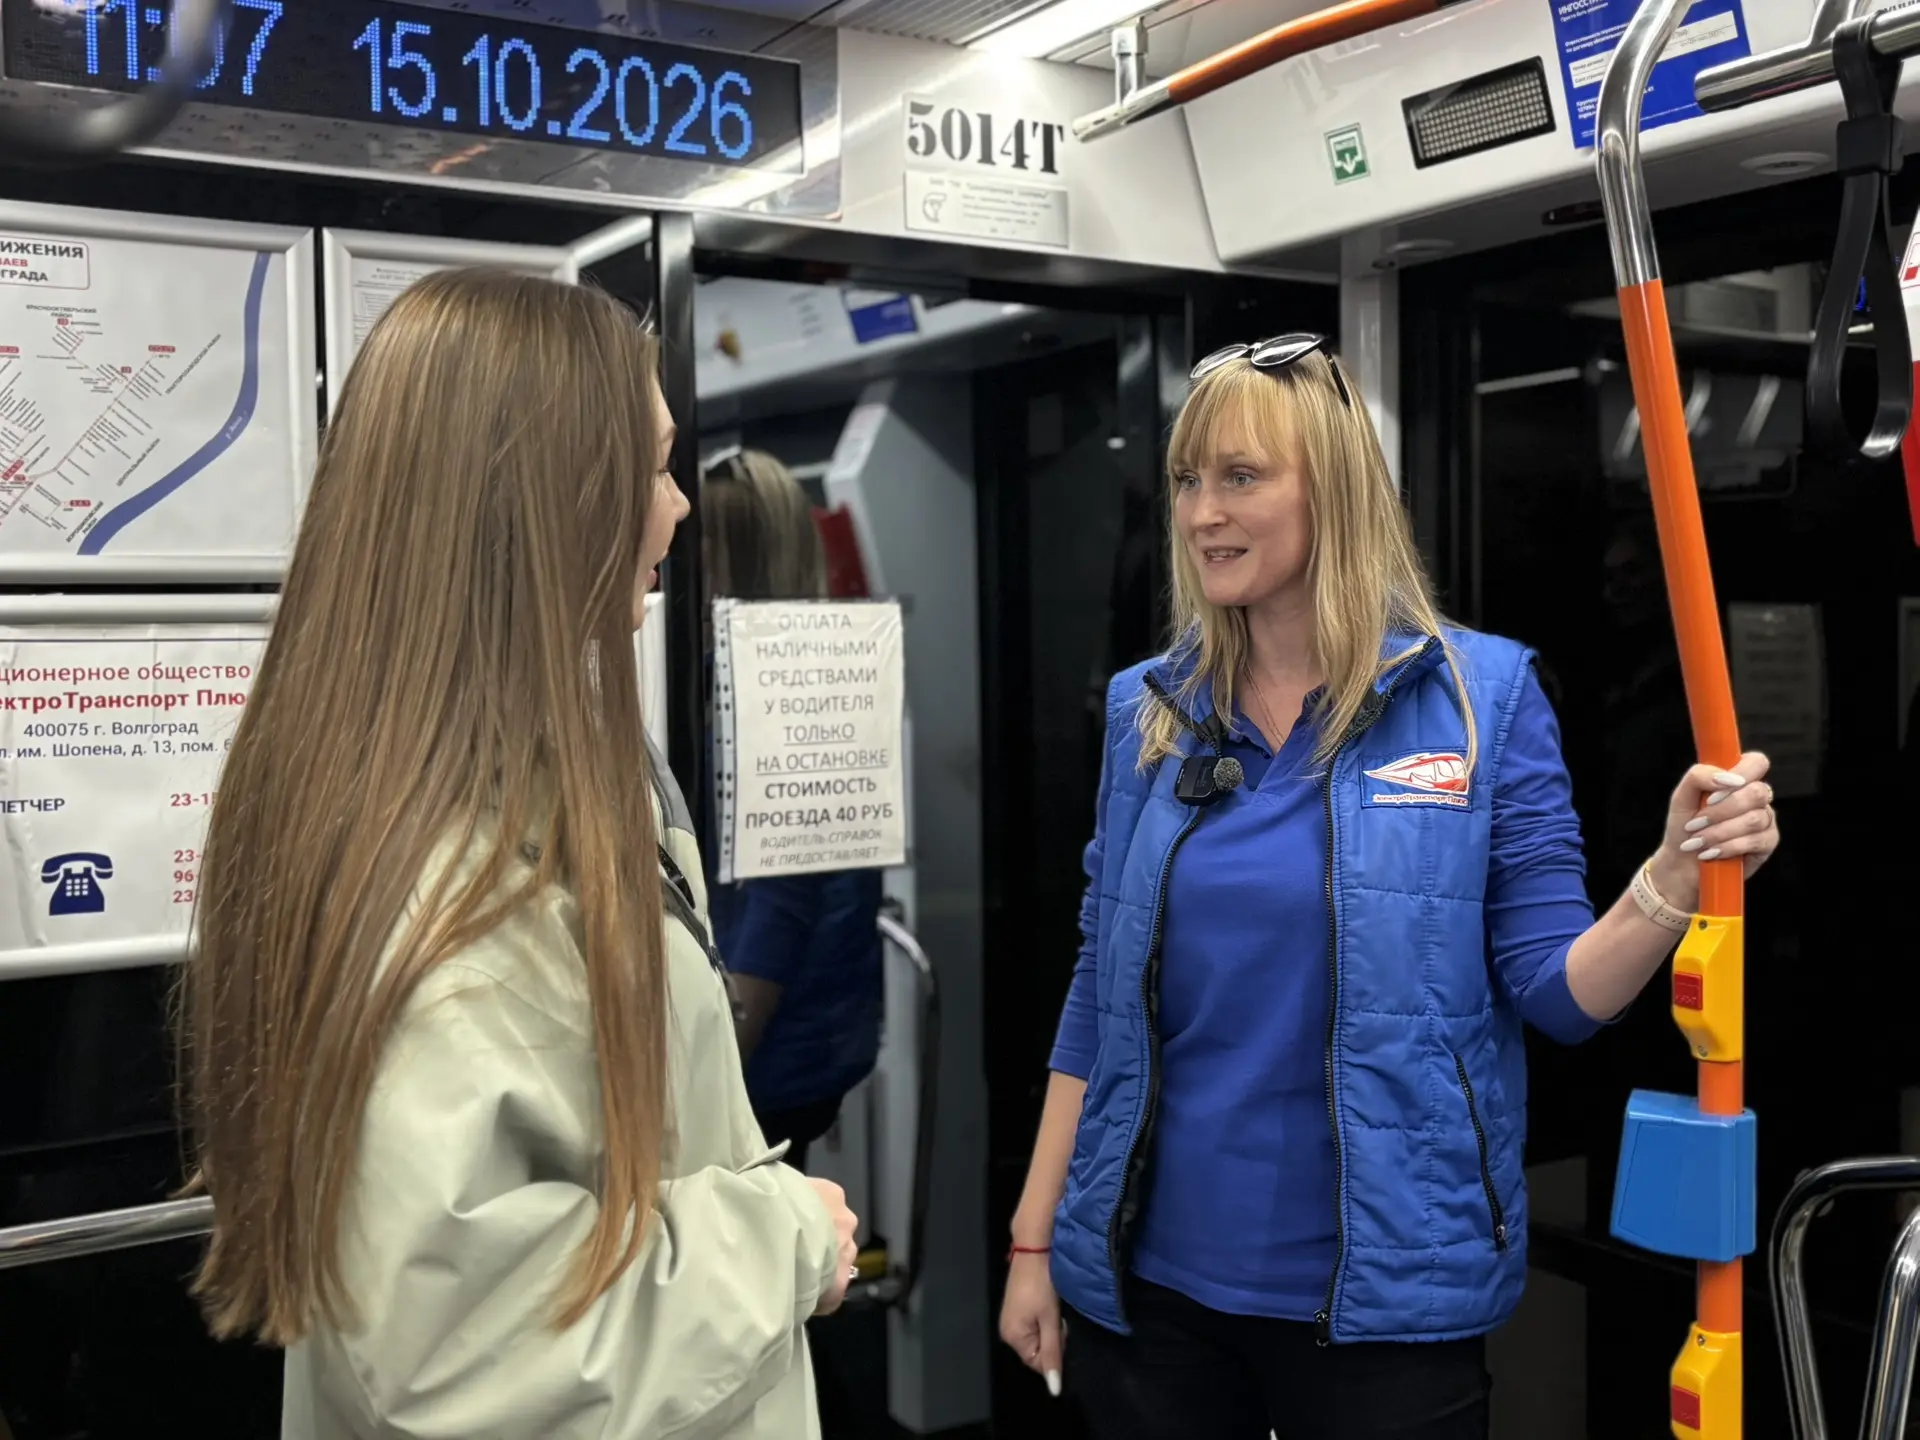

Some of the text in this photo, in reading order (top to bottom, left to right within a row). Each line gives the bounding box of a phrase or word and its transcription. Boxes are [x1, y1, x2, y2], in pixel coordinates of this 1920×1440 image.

[352, 17, 753, 160] 15.10.2026
[907, 101, 1064, 174] 5014T
[0, 241, 84, 259] ИЖЕНИЯ
[0, 257, 28, 267] АЕВ
[778, 613, 852, 630] ОПЛАТА
[755, 640, 878, 659] НАЛИЧНЫМИ
[137, 661, 251, 683] общество
[758, 668, 878, 688] СРЕДСТВАМИ
[0, 690, 189, 714] ктроТранспорт
[764, 695, 875, 715] У ВОДИТЕЛЯ
[23, 721, 199, 737] 400075 г. Волгоград
[784, 722, 856, 743] ТОЛЬКО
[17, 747, 46, 758] им.
[52, 743, 126, 757] Шопена,
[131, 743, 147, 756] д.
[153, 740, 176, 755] 13,
[181, 741, 218, 753] пом.
[756, 749, 889, 773] НА ОСТАНОВКЕ
[764, 776, 877, 799] СТОИМОСТЬ
[745, 803, 893, 829] ПРОЕЗДА 40 РУБ
[828, 829, 883, 844] СПРАВОК
[760, 855, 776, 867] НЕ
